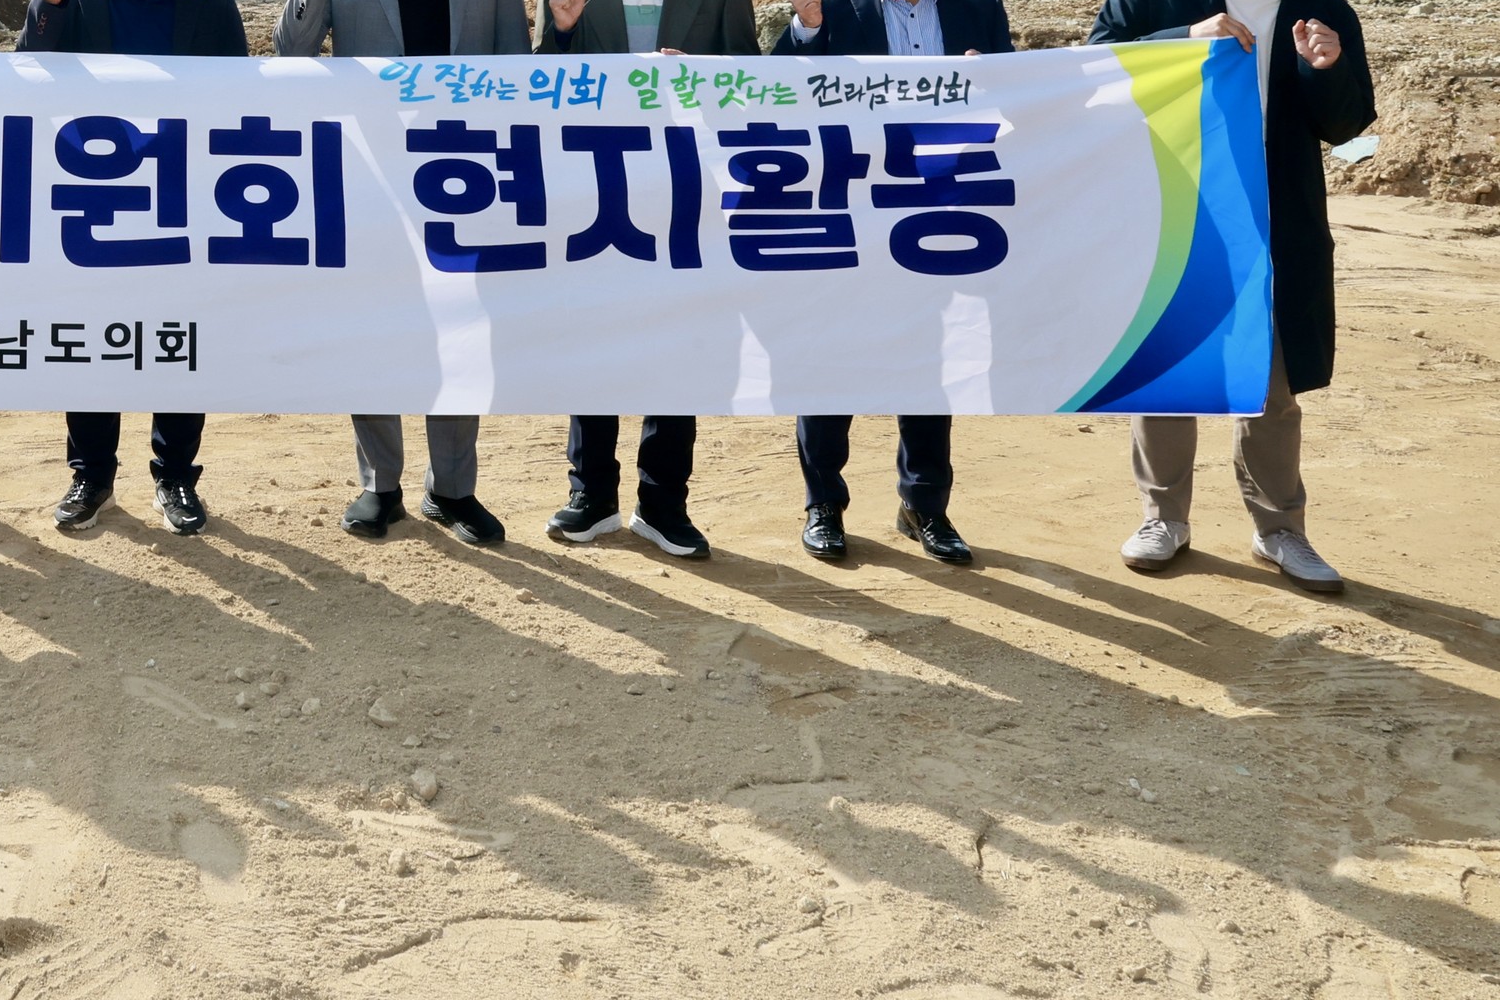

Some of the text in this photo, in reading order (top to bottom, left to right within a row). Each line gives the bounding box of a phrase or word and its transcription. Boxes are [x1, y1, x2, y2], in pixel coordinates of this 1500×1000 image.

[379, 61, 435, 103] 일
[434, 63, 519, 103] 잘하는
[528, 63, 607, 110] 의회
[713, 69, 798, 109] 맛나는
[807, 71, 971, 111] 전라남도의회
[405, 119, 1016, 276] 현지활동
